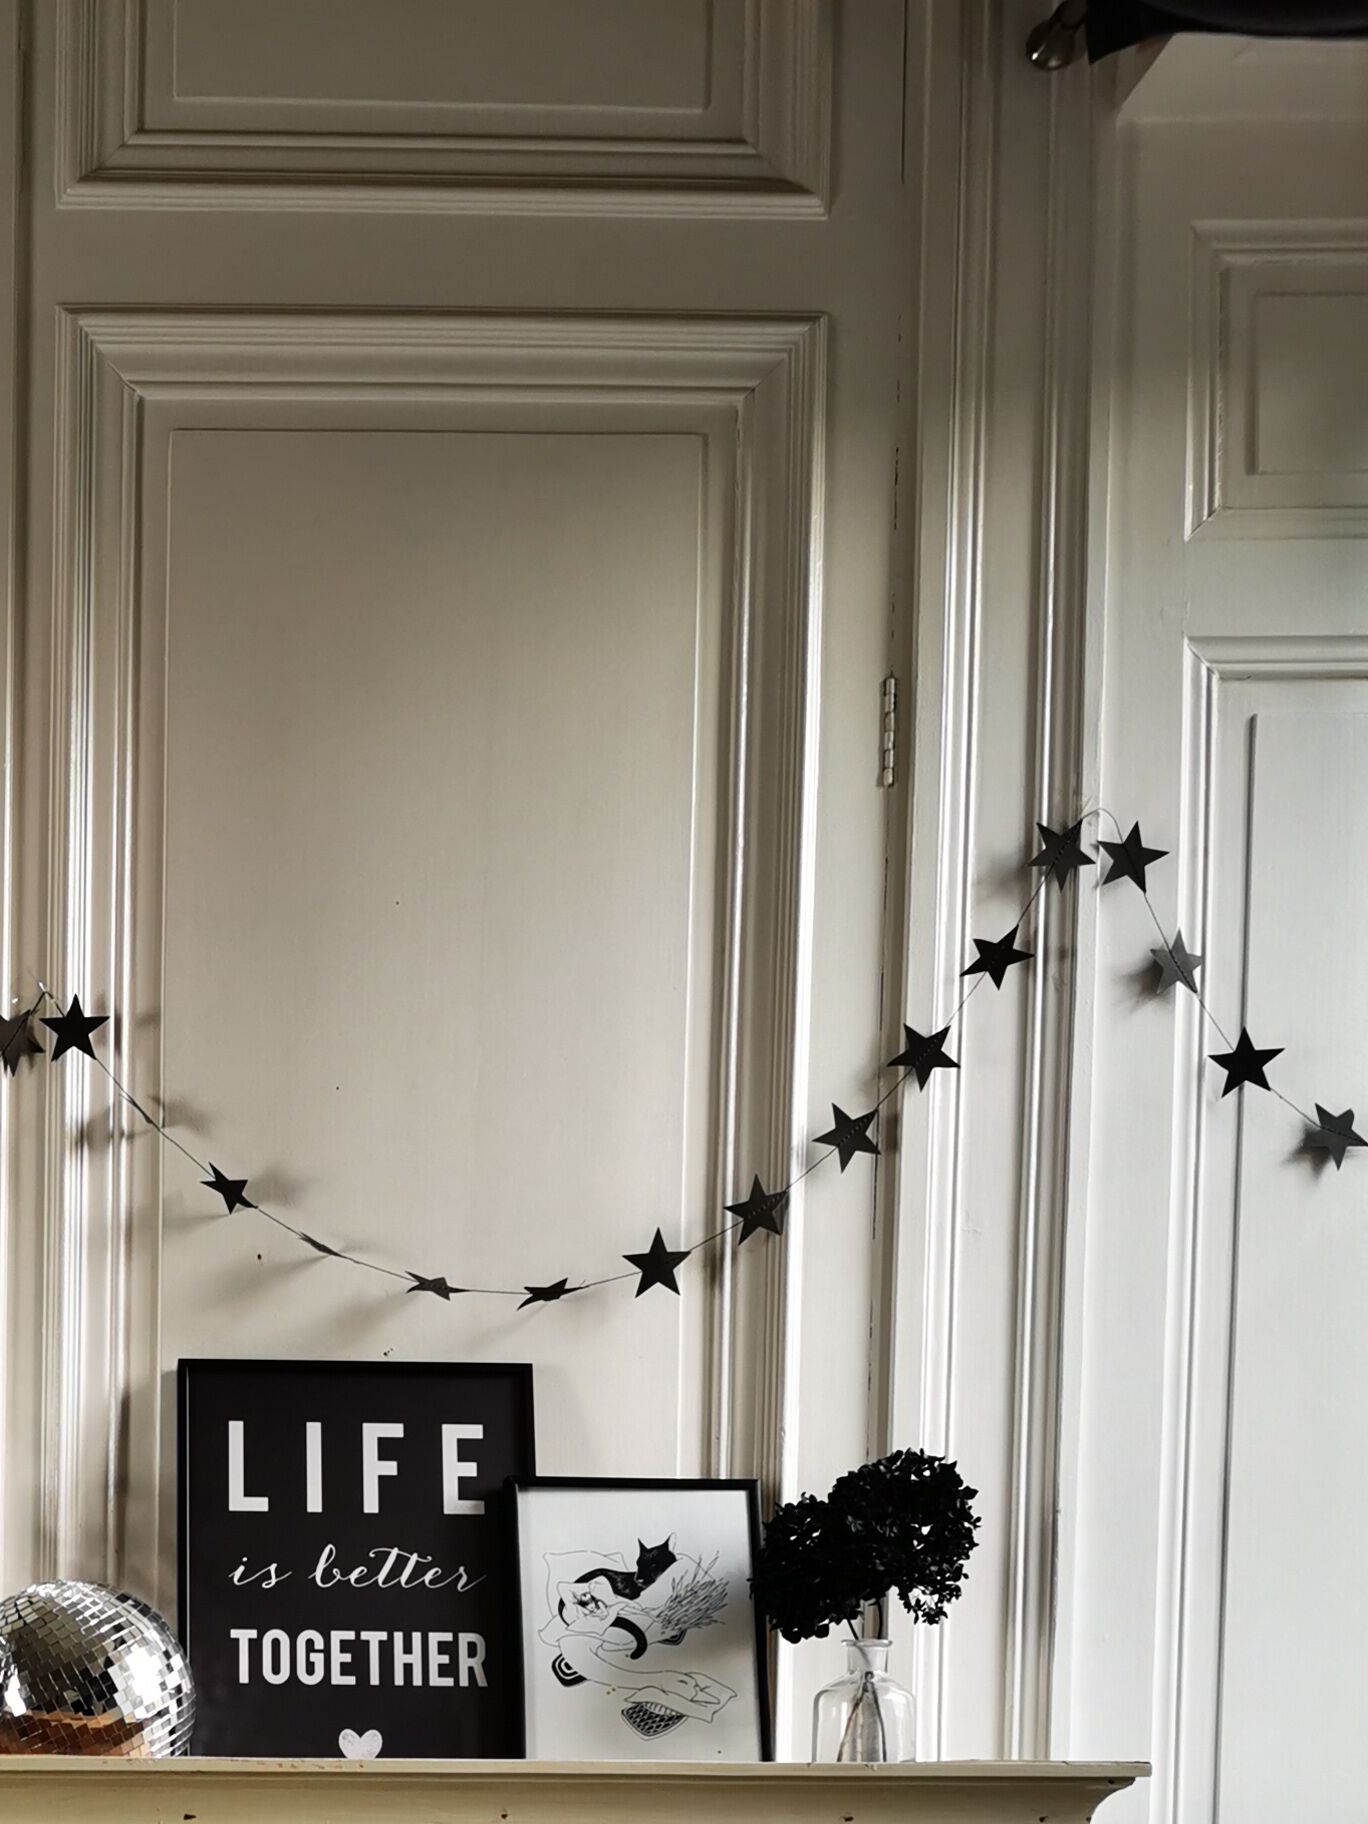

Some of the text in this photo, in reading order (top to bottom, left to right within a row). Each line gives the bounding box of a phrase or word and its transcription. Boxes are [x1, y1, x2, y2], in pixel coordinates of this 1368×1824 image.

[228, 1421, 485, 1515] LIFE
[228, 1543, 488, 1593] is better
[229, 1628, 489, 1687] TOGETHER
